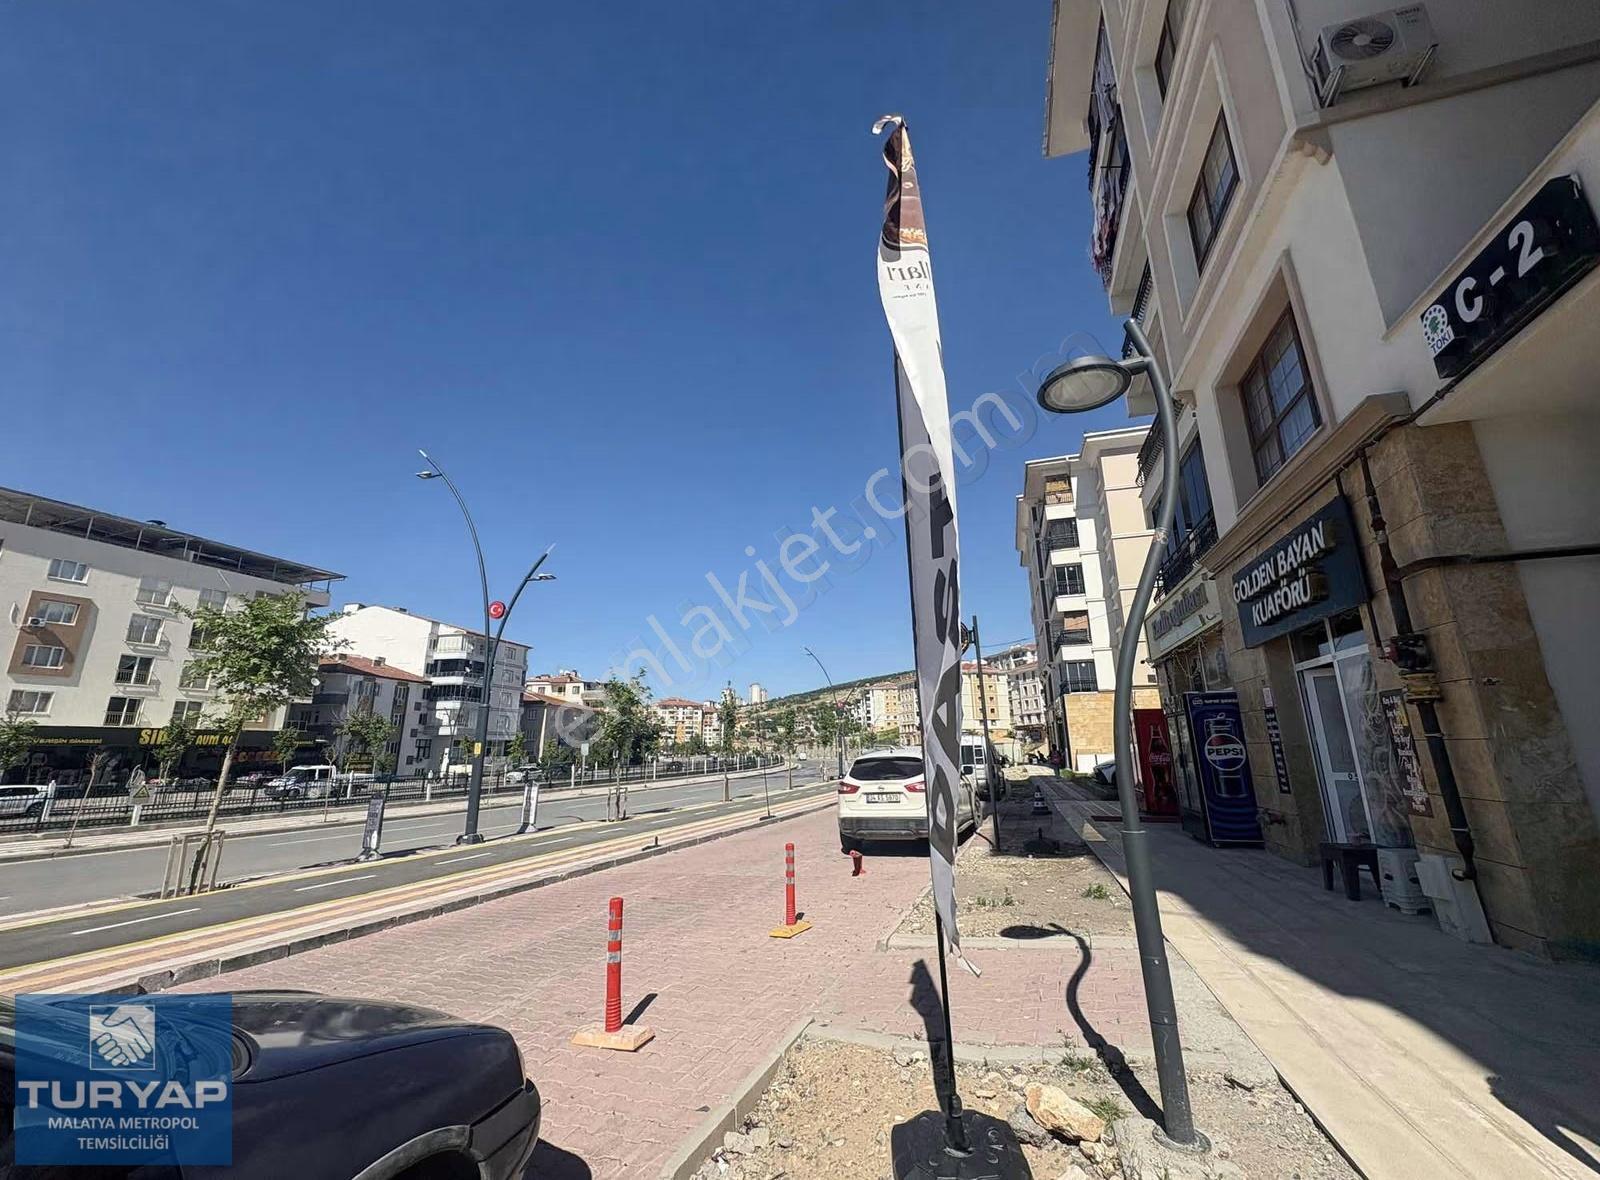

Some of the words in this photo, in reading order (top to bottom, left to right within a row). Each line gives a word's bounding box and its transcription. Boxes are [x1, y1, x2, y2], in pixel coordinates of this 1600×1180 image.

[1232, 556, 1276, 603] GOLDEN
[1276, 520, 1326, 576] BAYAN
[1252, 567, 1311, 627] KUAFÖRÜ
[1208, 747, 1243, 756] PEPSI
